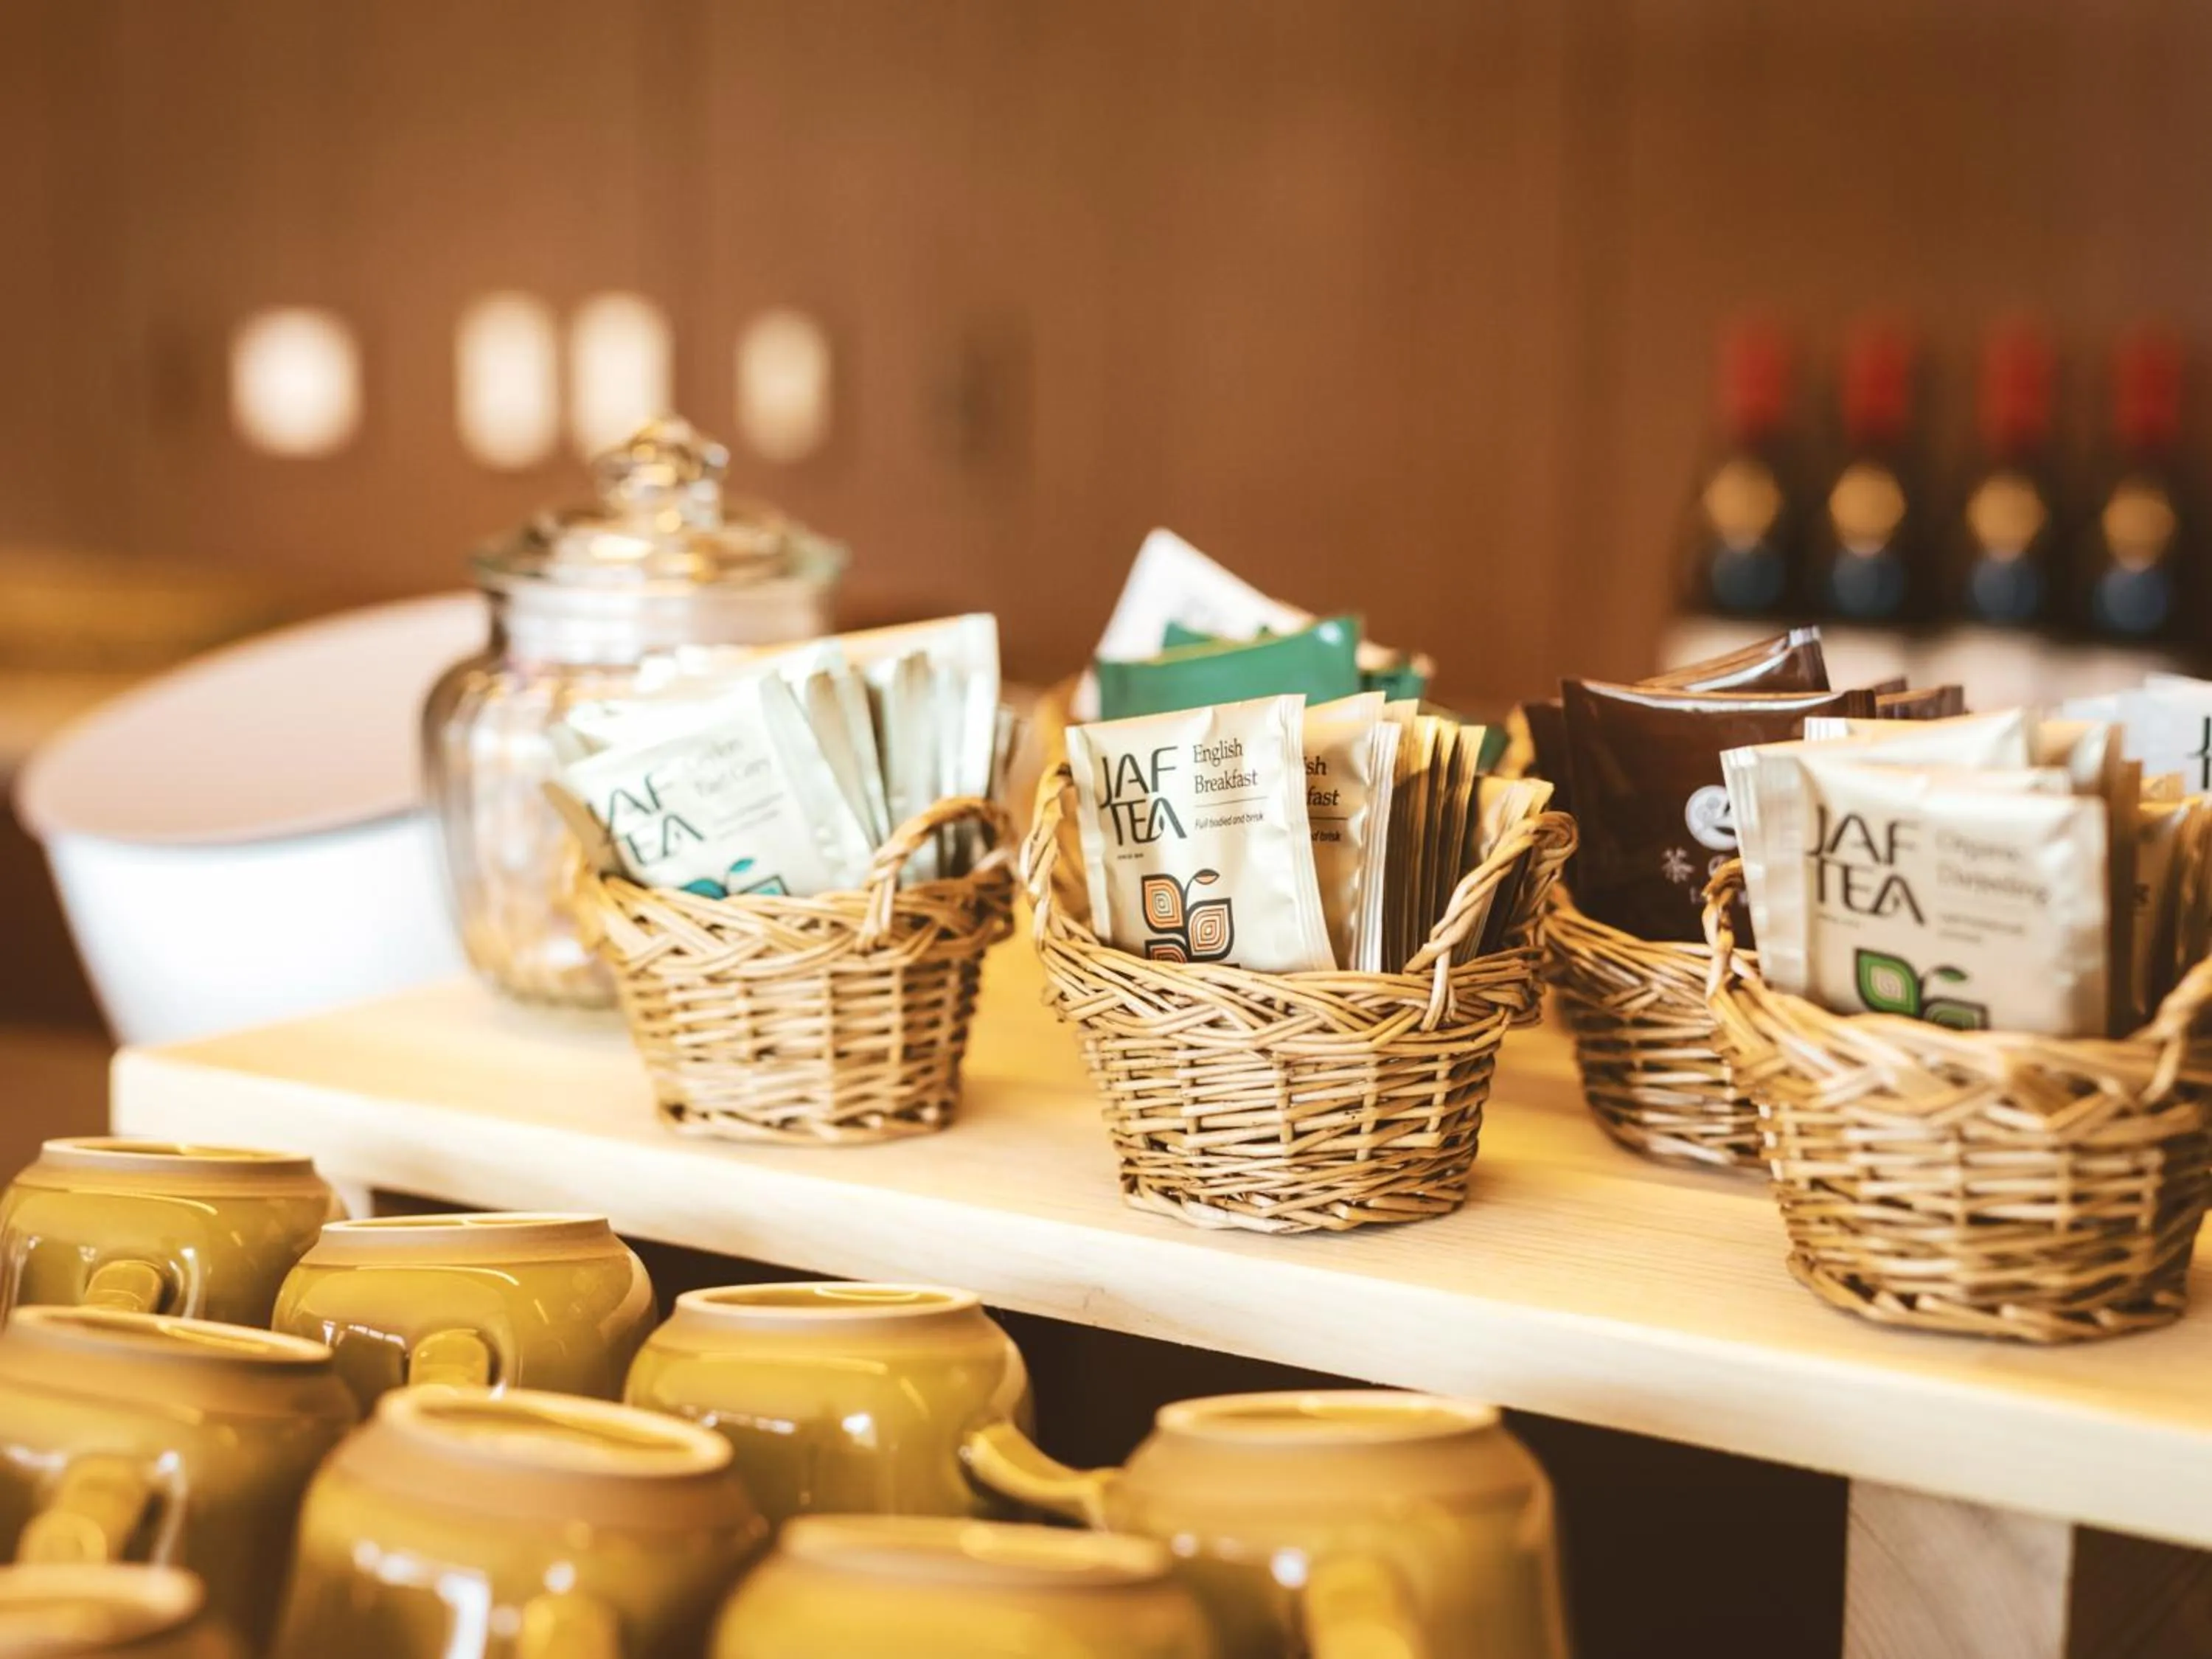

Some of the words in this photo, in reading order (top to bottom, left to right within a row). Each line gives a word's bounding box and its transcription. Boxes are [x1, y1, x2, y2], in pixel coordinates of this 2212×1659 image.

[1099, 745, 1178, 809] JAF
[1193, 738, 1244, 767] English
[1194, 768, 1259, 794] Breakfast
[1110, 797, 1188, 846] TEA
[1805, 803, 1921, 866] JAF
[1816, 854, 1927, 926] TEA
